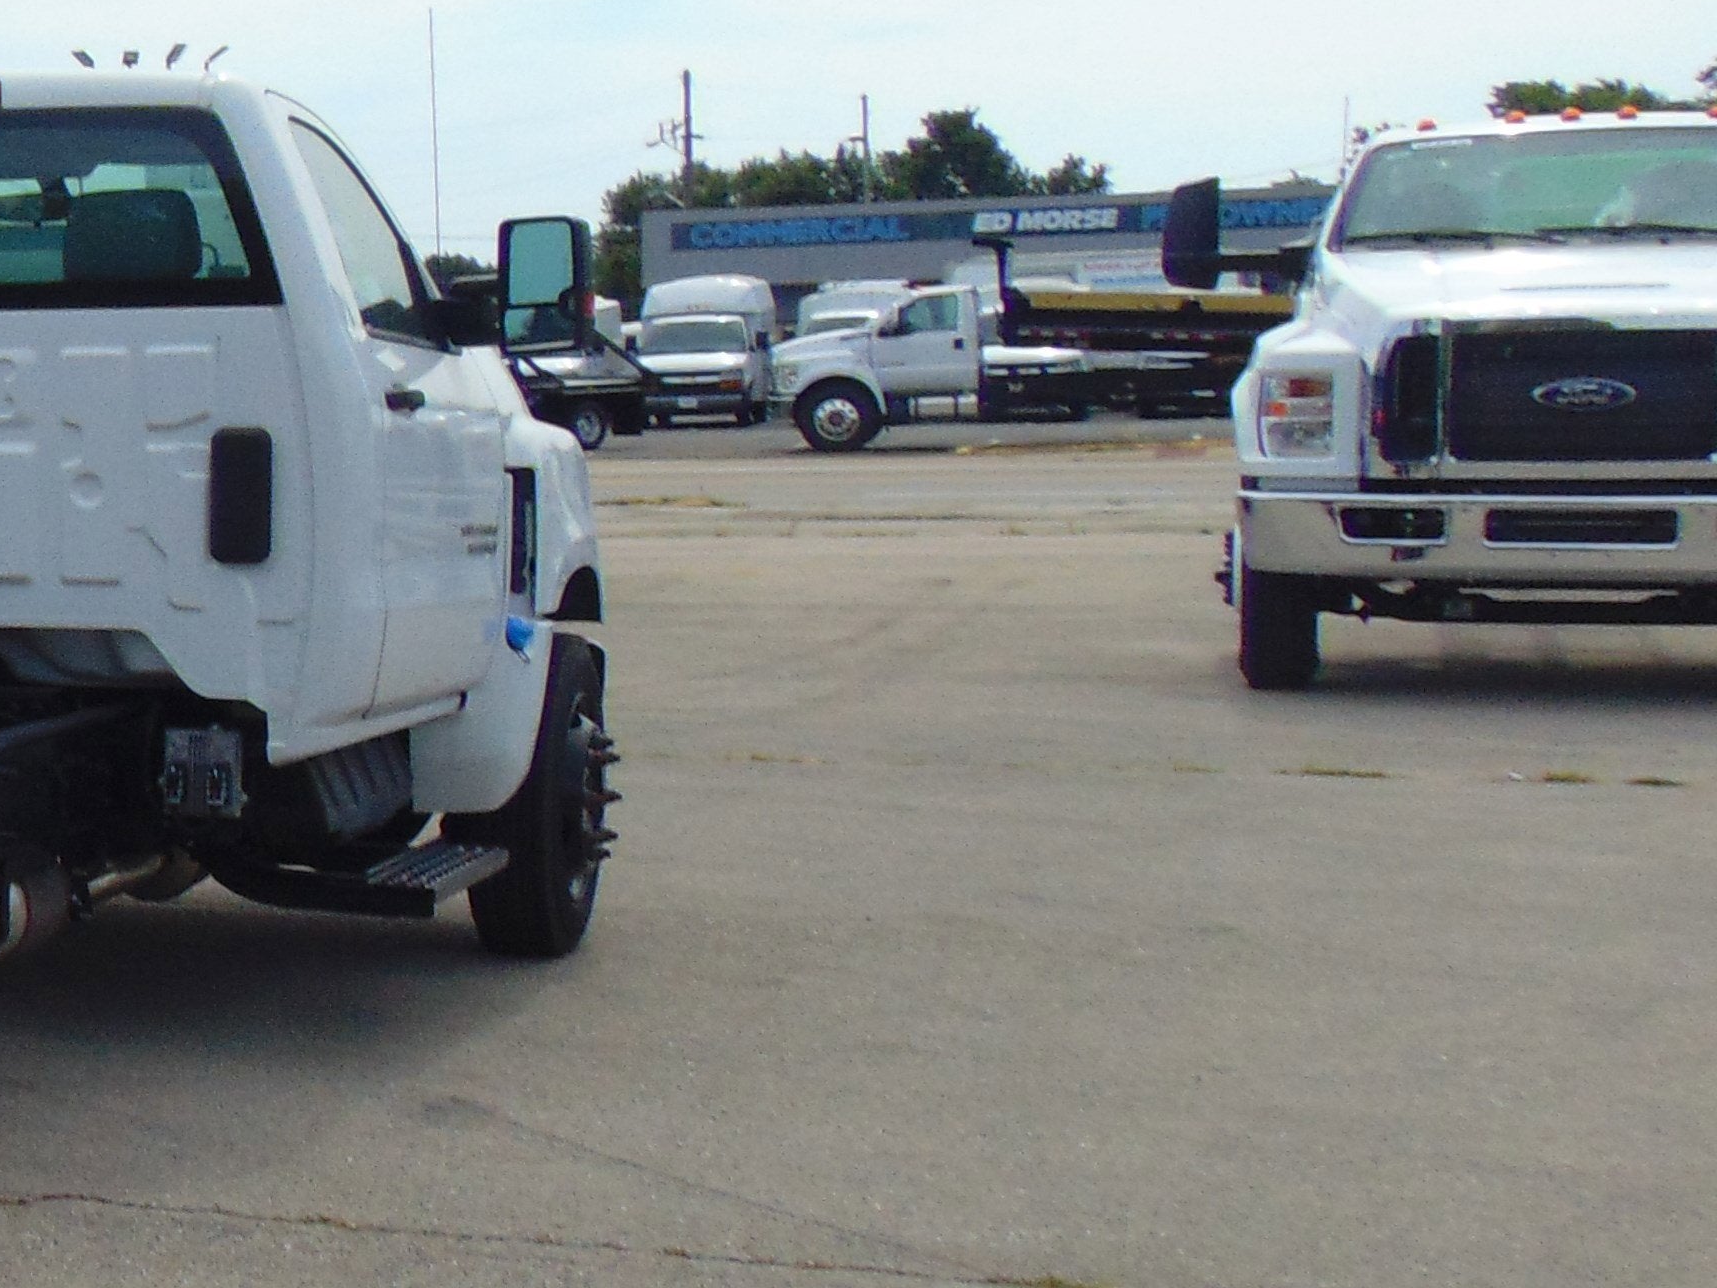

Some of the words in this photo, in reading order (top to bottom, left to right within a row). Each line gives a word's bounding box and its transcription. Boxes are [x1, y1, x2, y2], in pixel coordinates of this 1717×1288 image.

[690, 215, 911, 247] COMMERCIAL
[973, 211, 1013, 233] ED
[1016, 207, 1119, 231] MORSE
